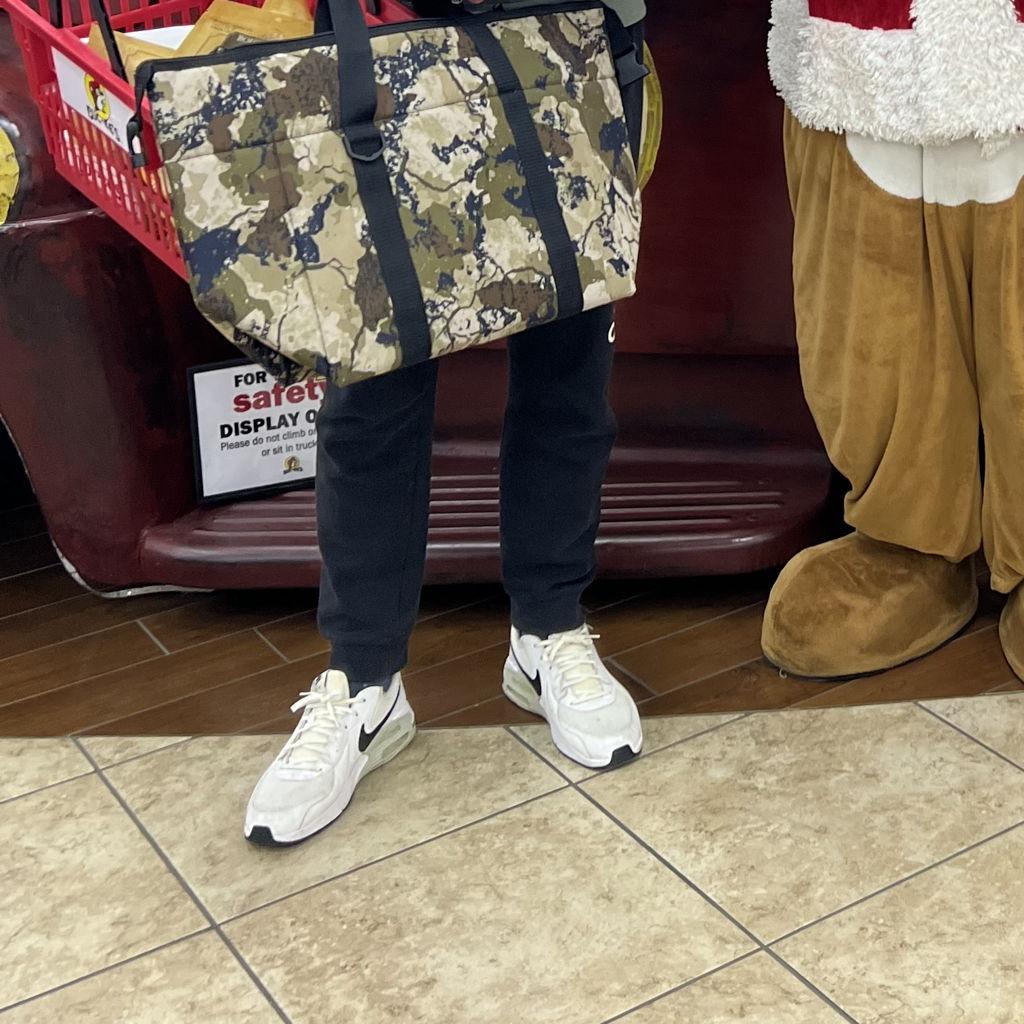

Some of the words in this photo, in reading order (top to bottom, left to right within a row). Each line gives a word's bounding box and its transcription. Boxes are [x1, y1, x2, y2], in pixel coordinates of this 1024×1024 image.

[234, 371, 267, 388] FOR
[220, 411, 299, 439] DISPLAY
[220, 438, 250, 451] Please
[252, 436, 263, 446] do
[266, 434, 280, 443] not
[282, 429, 306, 441] climb
[261, 448, 270, 456] or
[272, 446, 283, 455] sit
[285, 443, 294, 452] in
